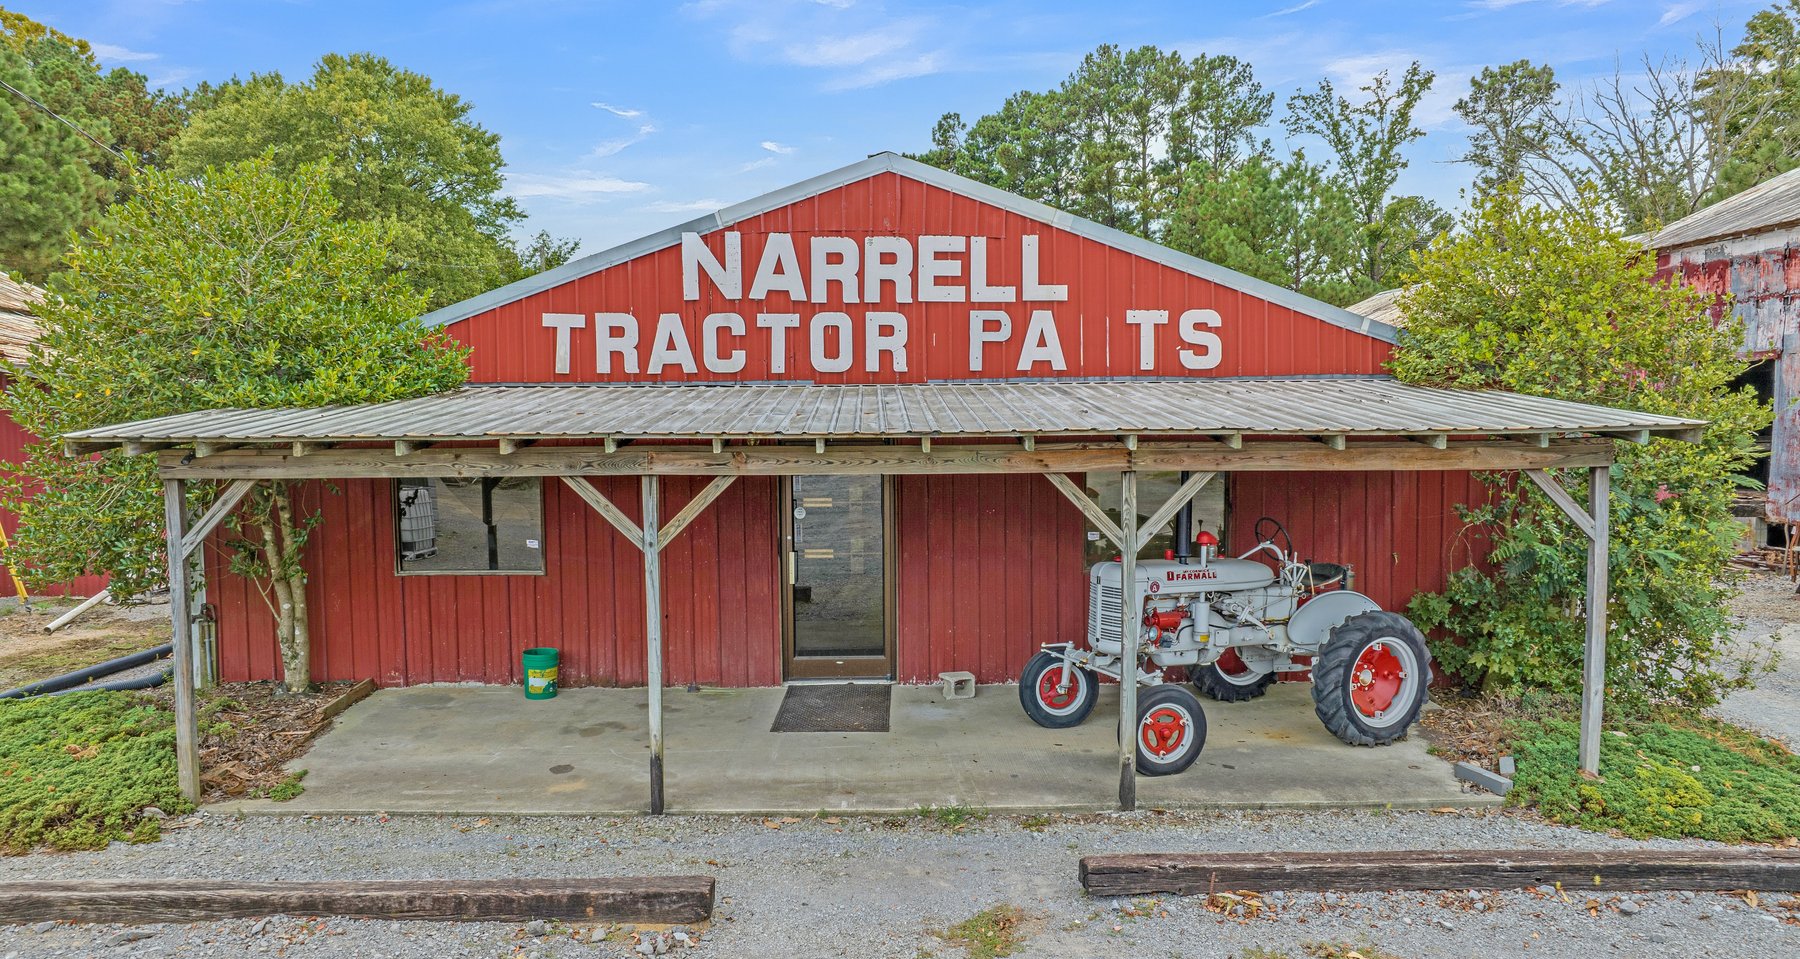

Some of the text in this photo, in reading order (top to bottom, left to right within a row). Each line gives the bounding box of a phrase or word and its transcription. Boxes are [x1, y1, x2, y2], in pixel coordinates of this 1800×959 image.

[681, 231, 1068, 303] NARRELL
[542, 310, 1222, 374] TRACTOR PATS
[1176, 572, 1217, 580] FARMALL
